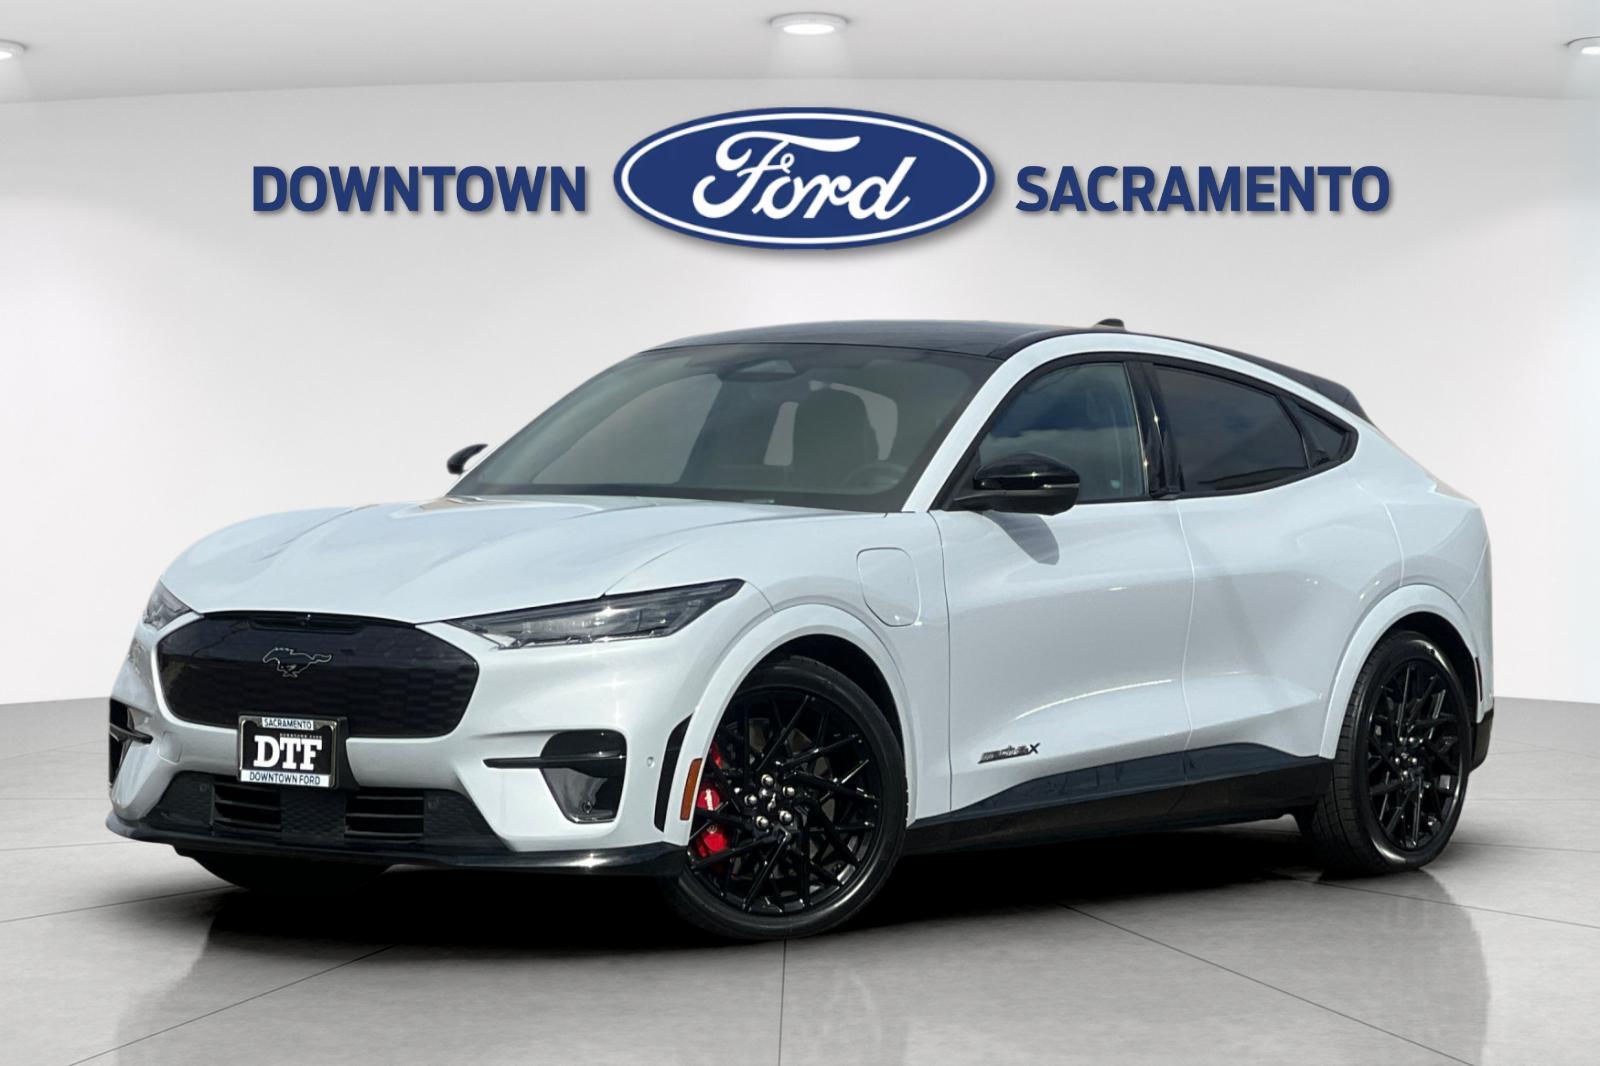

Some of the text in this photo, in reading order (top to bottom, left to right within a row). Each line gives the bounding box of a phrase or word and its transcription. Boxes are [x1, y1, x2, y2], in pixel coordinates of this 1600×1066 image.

[253, 132, 1390, 220] DOWNTOWN Ford SACRAMENTO
[263, 718, 312, 729] SACRAMENTO
[253, 735, 323, 771] DTF
[249, 772, 321, 785] DOWNTOWN FORD
